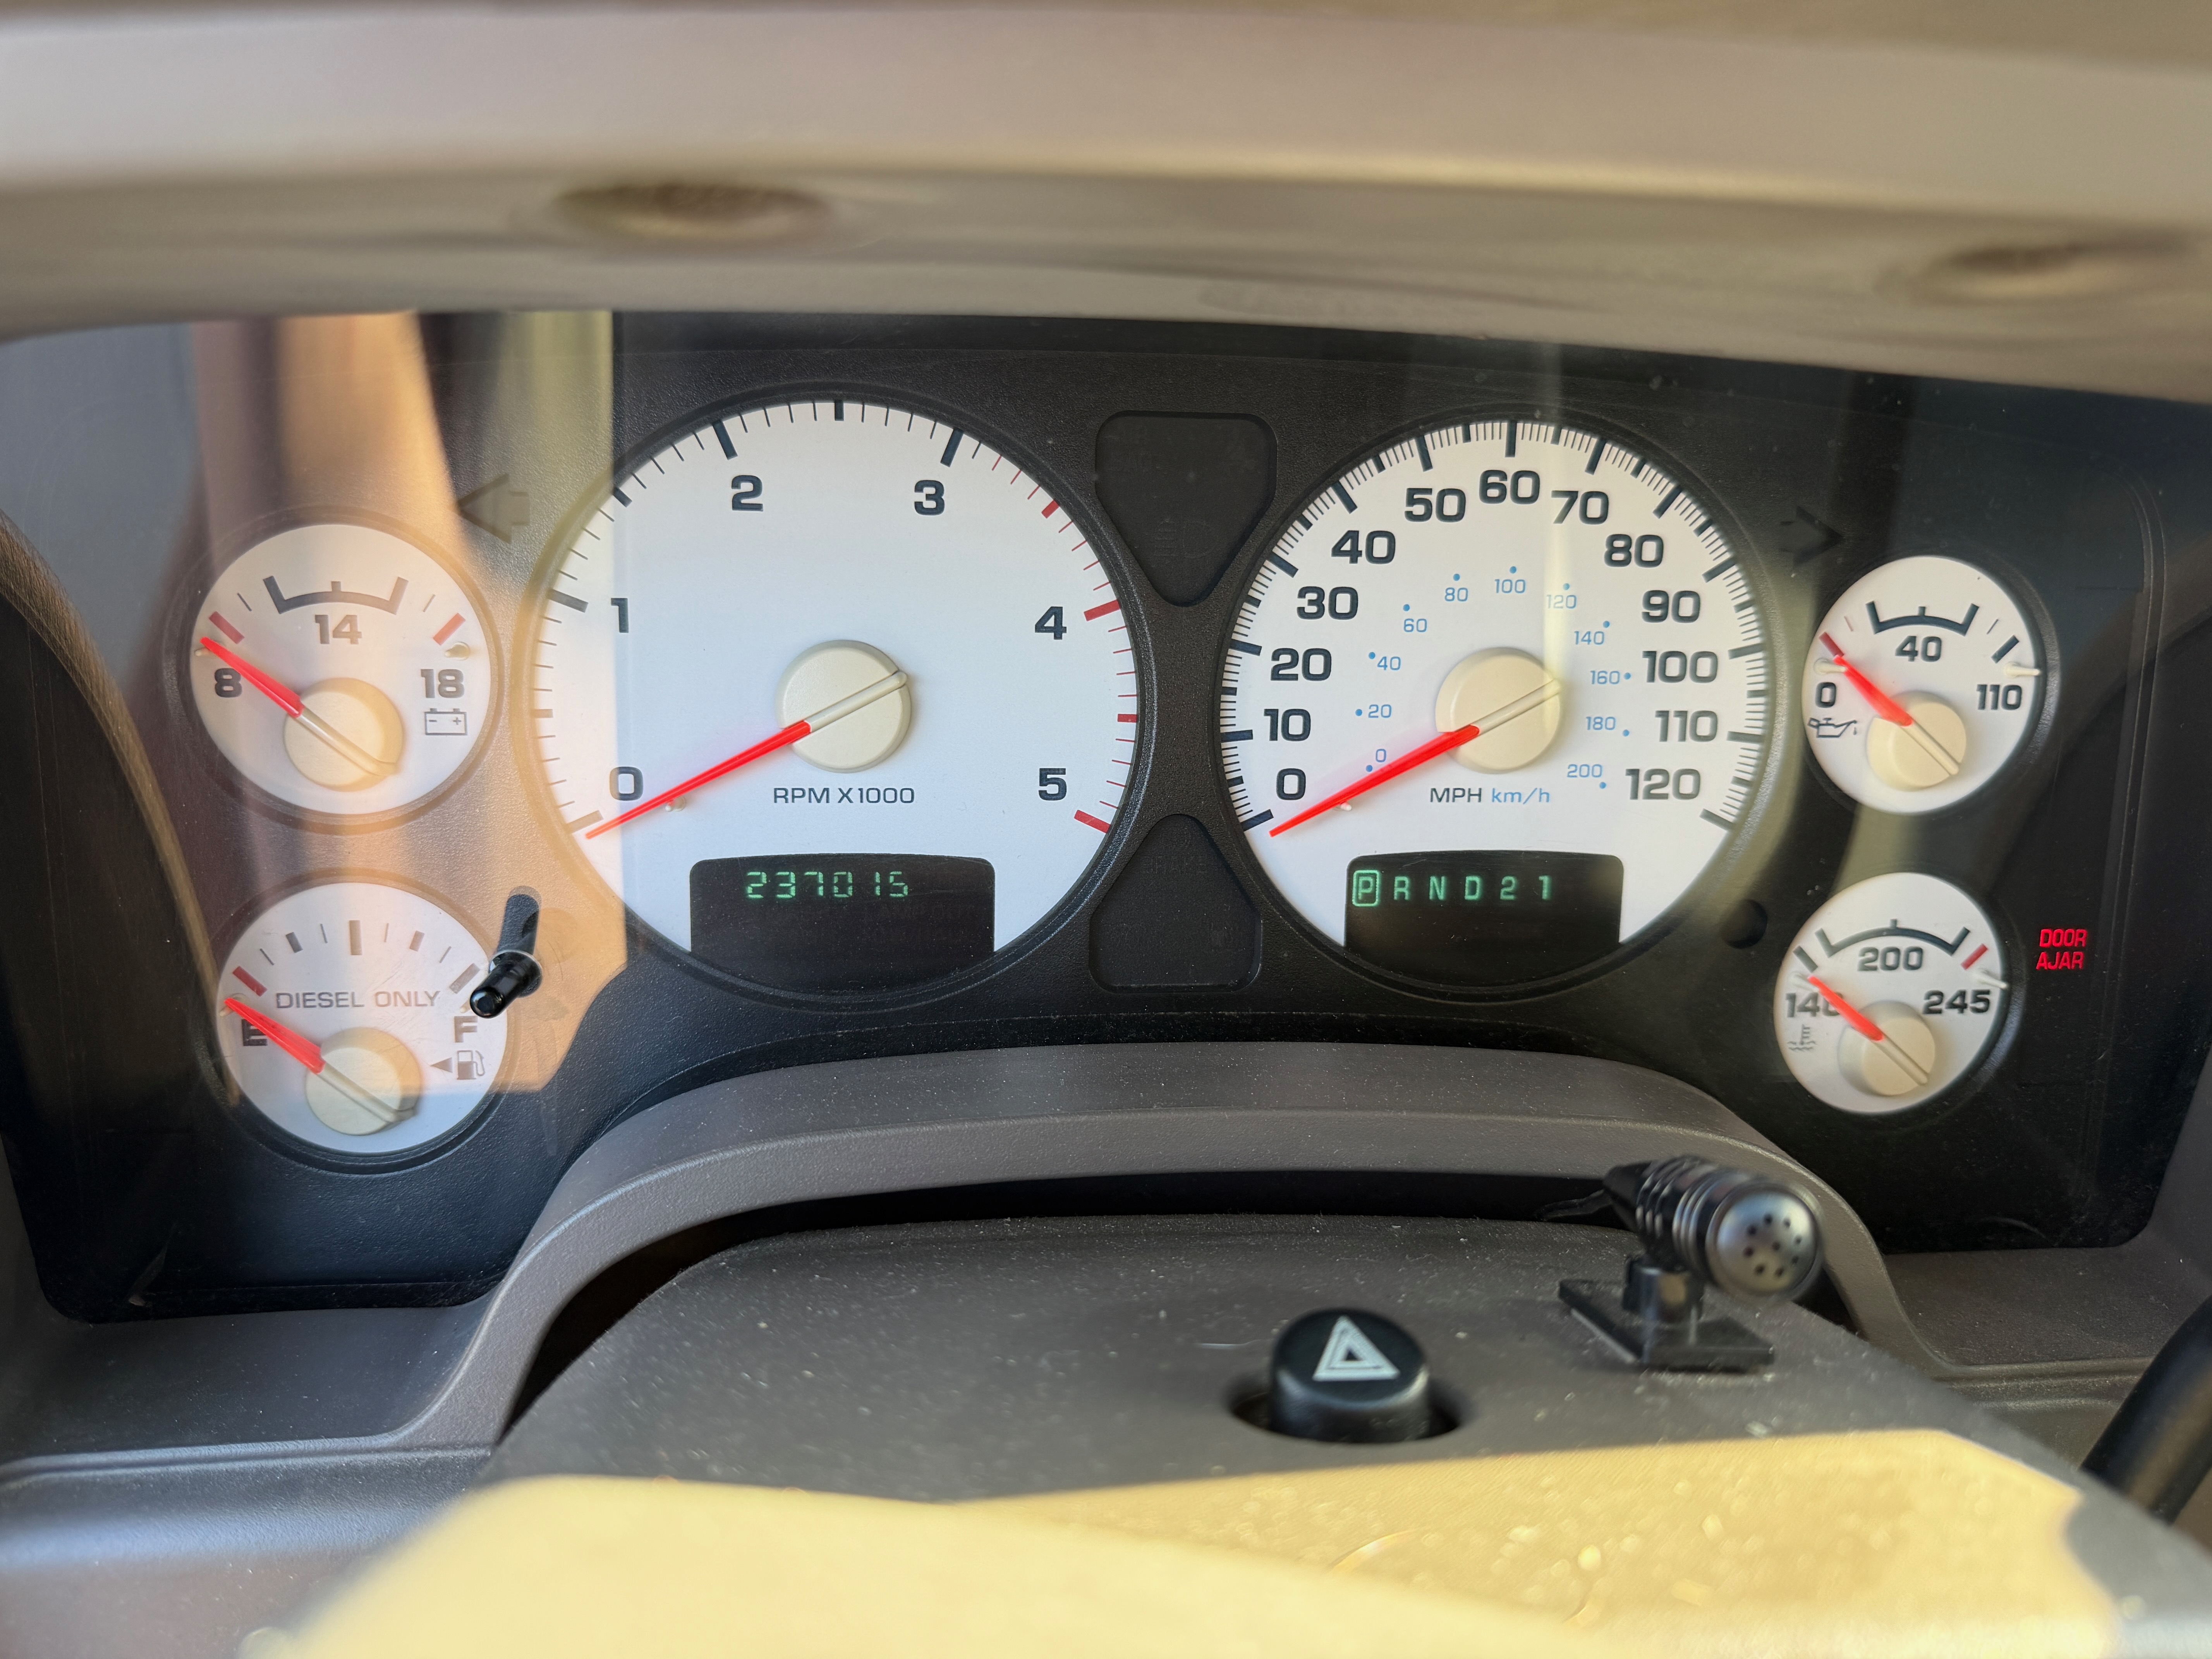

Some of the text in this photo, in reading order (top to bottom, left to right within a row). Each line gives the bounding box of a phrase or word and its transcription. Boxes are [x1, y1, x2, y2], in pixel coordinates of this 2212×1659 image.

[731, 474, 763, 512] 2
[914, 479, 945, 516] 3
[1479, 469, 1540, 505] 60
[1404, 488, 1466, 522] 50
[1550, 490, 1610, 524] 70
[1331, 529, 1396, 564] 40
[1604, 534, 1665, 568] 80
[1444, 587, 1469, 603] 80
[1494, 578, 1526, 594] 100
[610, 597, 629, 633] 1
[1296, 586, 1359, 620] 30
[1546, 594, 1577, 609] 120
[1641, 590, 1701, 623] 90
[314, 615, 362, 644] 14
[1034, 606, 1067, 640] 4
[1402, 618, 1428, 634] 60
[1574, 631, 1605, 646] 140
[1895, 635, 1942, 662] 40
[1270, 647, 1332, 681] 20
[1376, 655, 1401, 671] 40
[1642, 650, 1719, 684] 100
[214, 668, 242, 698] 8
[421, 669, 465, 699] 18
[1590, 670, 1621, 686] 160
[1815, 682, 1836, 708] 0
[1976, 684, 2023, 710] 110
[1264, 708, 1312, 741] 10
[1367, 704, 1392, 719] 20
[1585, 716, 1616, 731] 180
[1655, 710, 1719, 743] 110
[1375, 749, 1388, 763] 0
[609, 766, 644, 801] 0
[1038, 768, 1068, 801] 5
[1276, 768, 1306, 800] 0
[1566, 764, 1603, 779] 200
[1625, 768, 1702, 800] 120
[773, 787, 830, 805] RPM
[1429, 787, 1550, 805] MPH km/h
[745, 871, 909, 899] 237015
[2039, 929, 2087, 948] DOOR
[1858, 946, 1923, 971] 200
[2036, 952, 2083, 970] AJAR
[276, 991, 441, 1009] DIESEL ONLY
[1922, 989, 1991, 1014] 245
[454, 1016, 477, 1042] F
